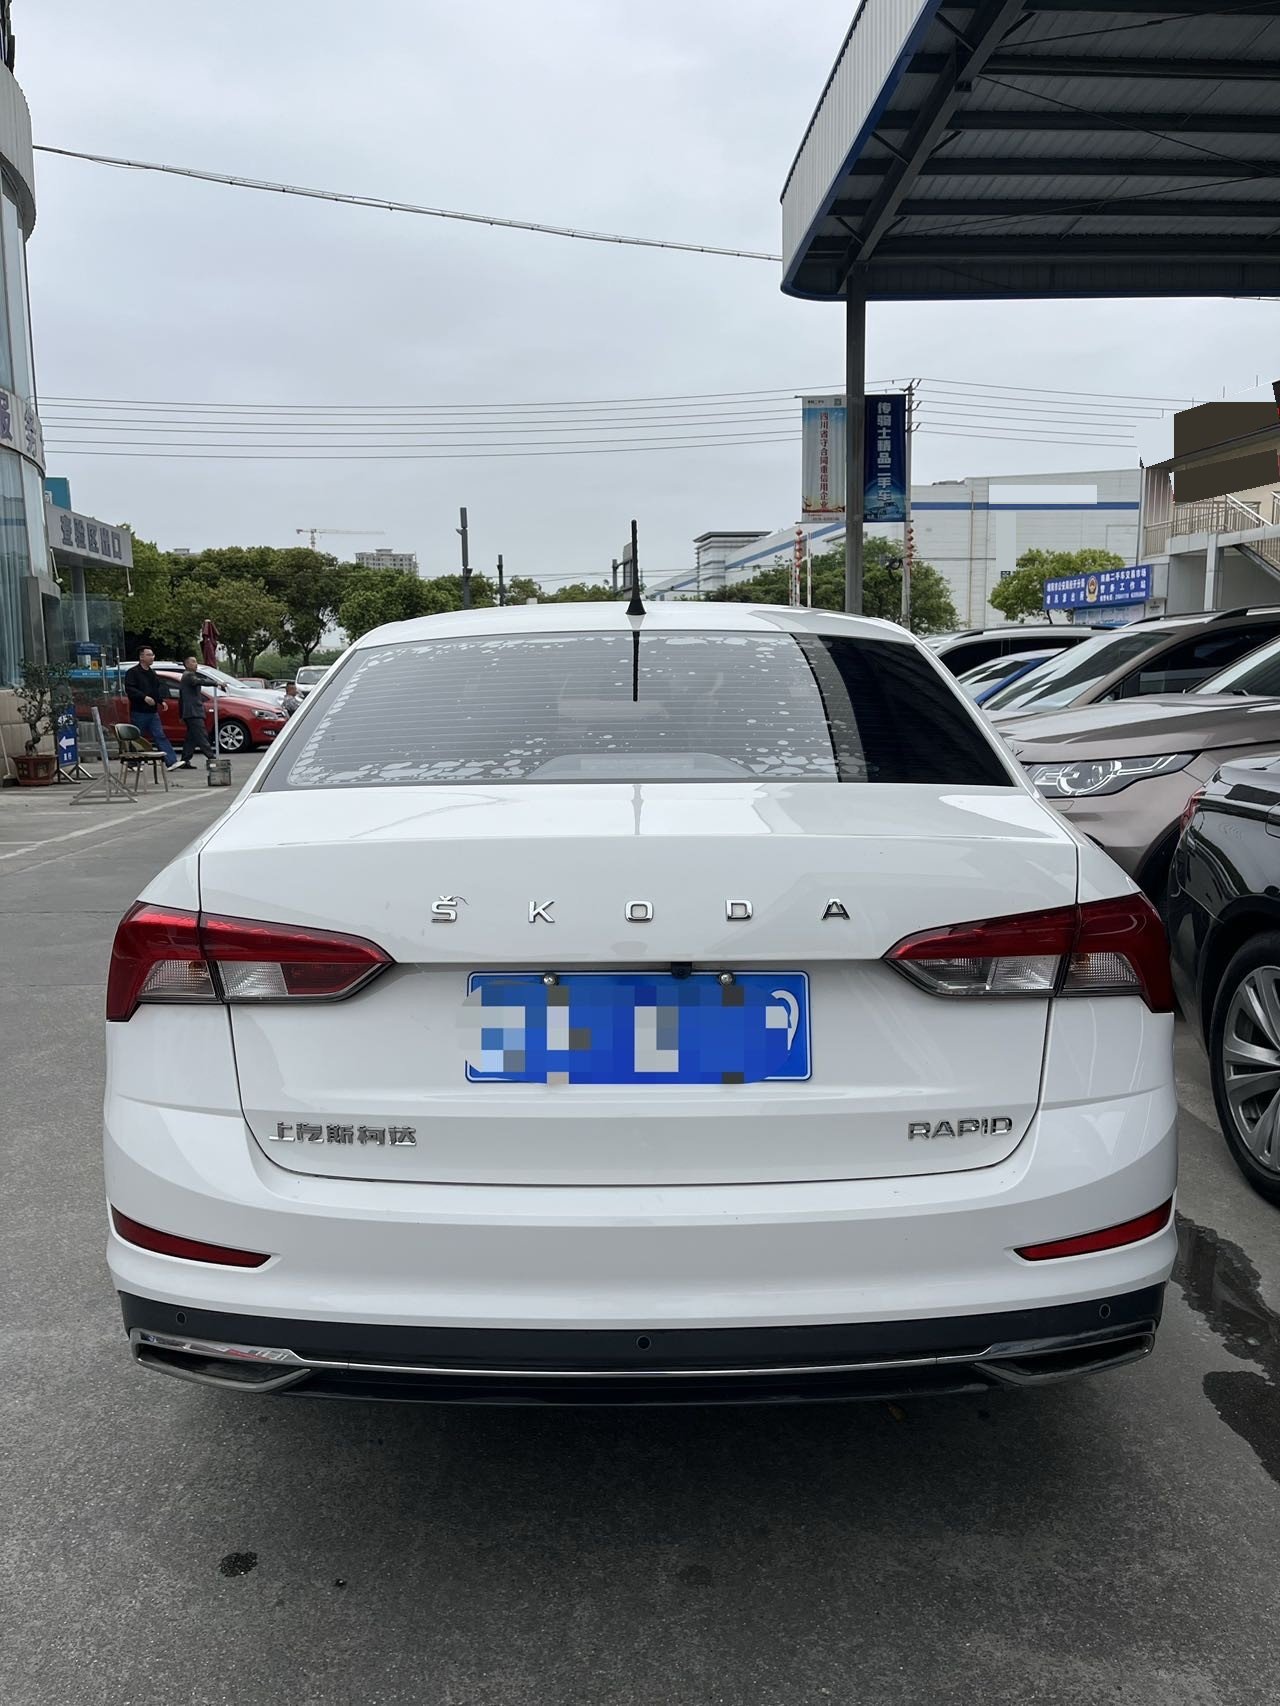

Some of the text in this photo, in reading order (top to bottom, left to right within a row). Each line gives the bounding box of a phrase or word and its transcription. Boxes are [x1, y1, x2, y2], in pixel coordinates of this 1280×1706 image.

[60, 514, 122, 560] 查验区出口
[268, 1122, 417, 1146] 上汽斯柯达
[908, 1117, 1013, 1140] RAPID
